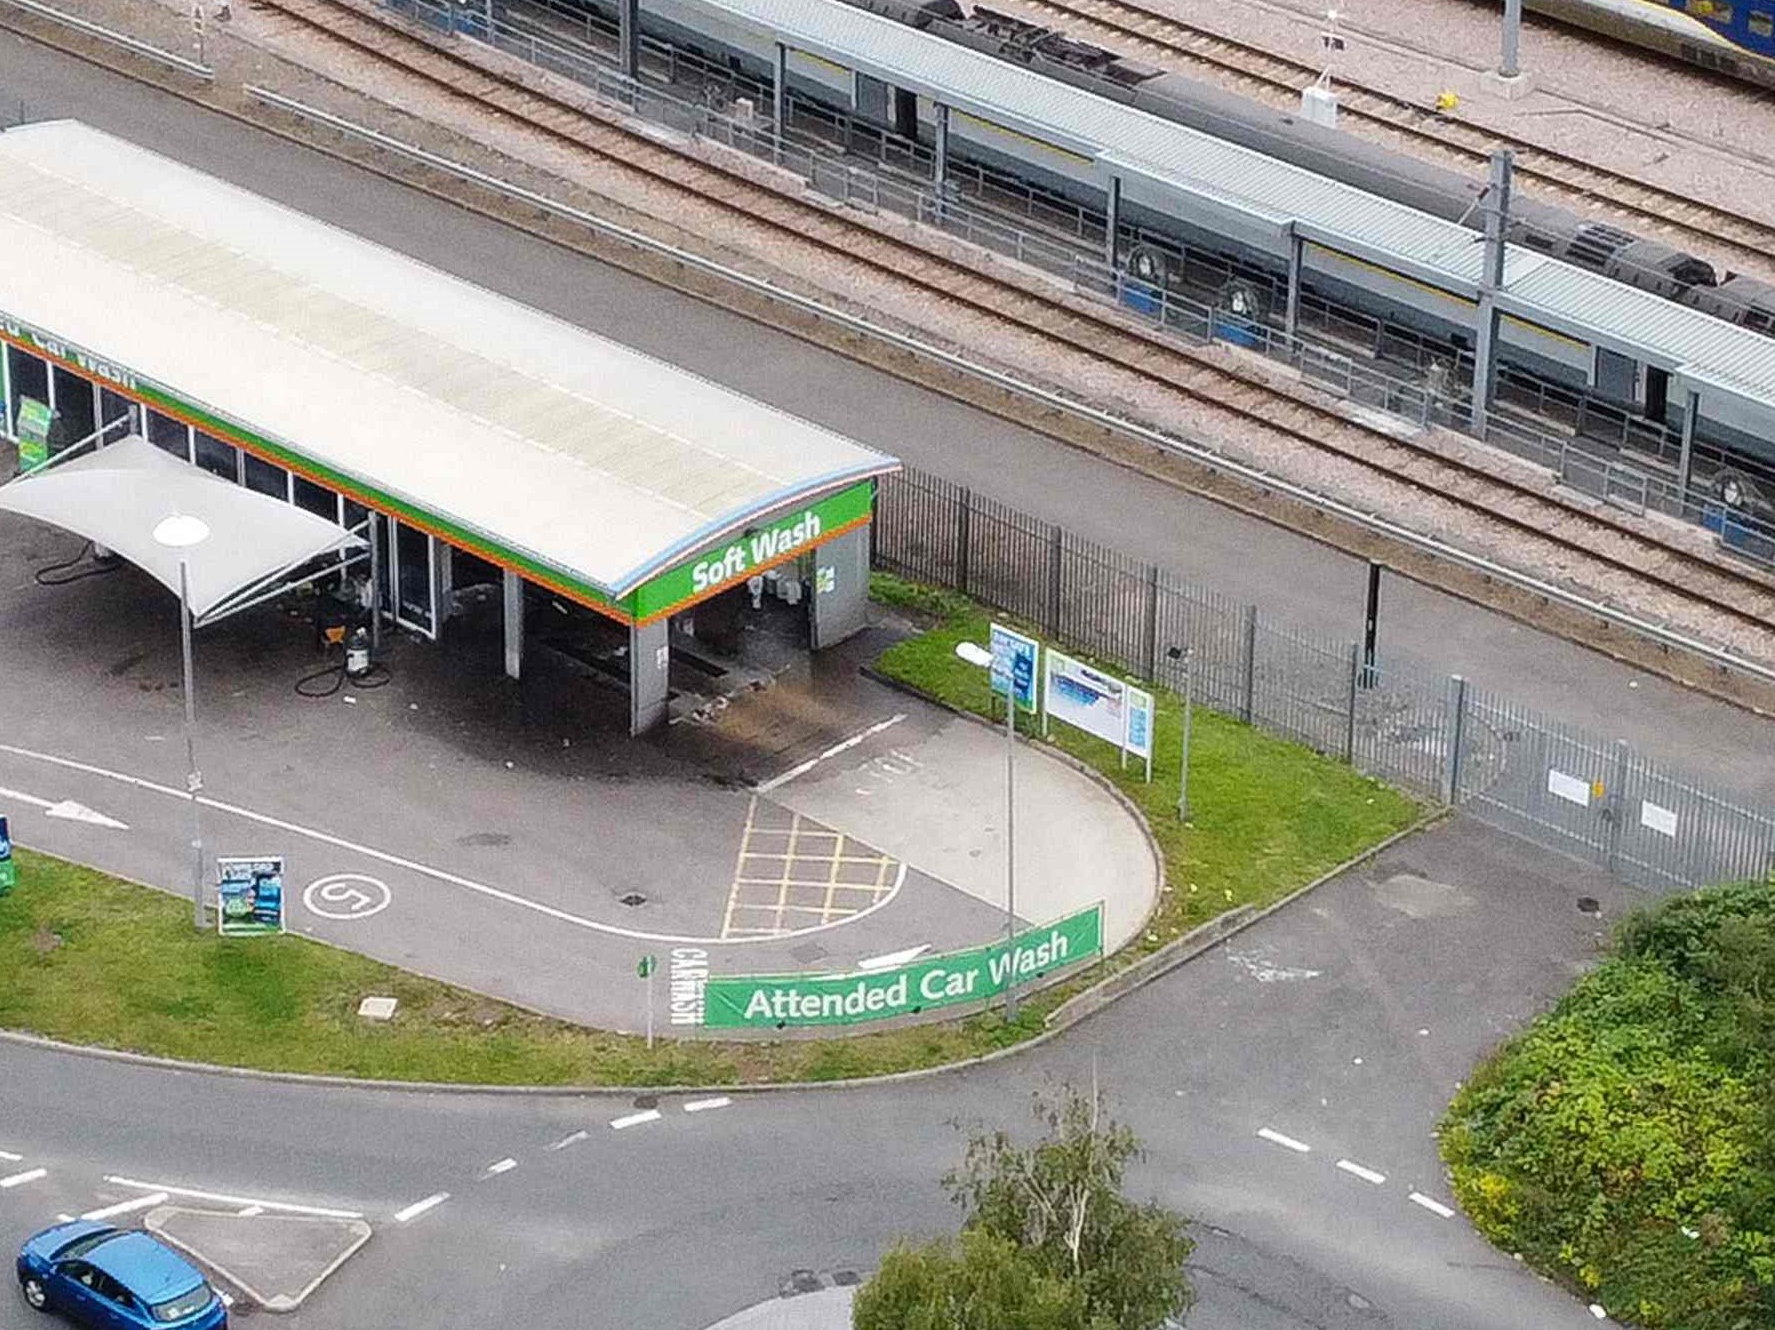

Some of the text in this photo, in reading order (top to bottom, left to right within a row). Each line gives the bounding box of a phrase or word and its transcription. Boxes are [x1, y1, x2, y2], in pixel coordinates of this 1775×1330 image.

[692, 511, 821, 593] Soft Wash
[320, 882, 372, 911] 5
[743, 930, 1069, 1020] Attended Car Wash
